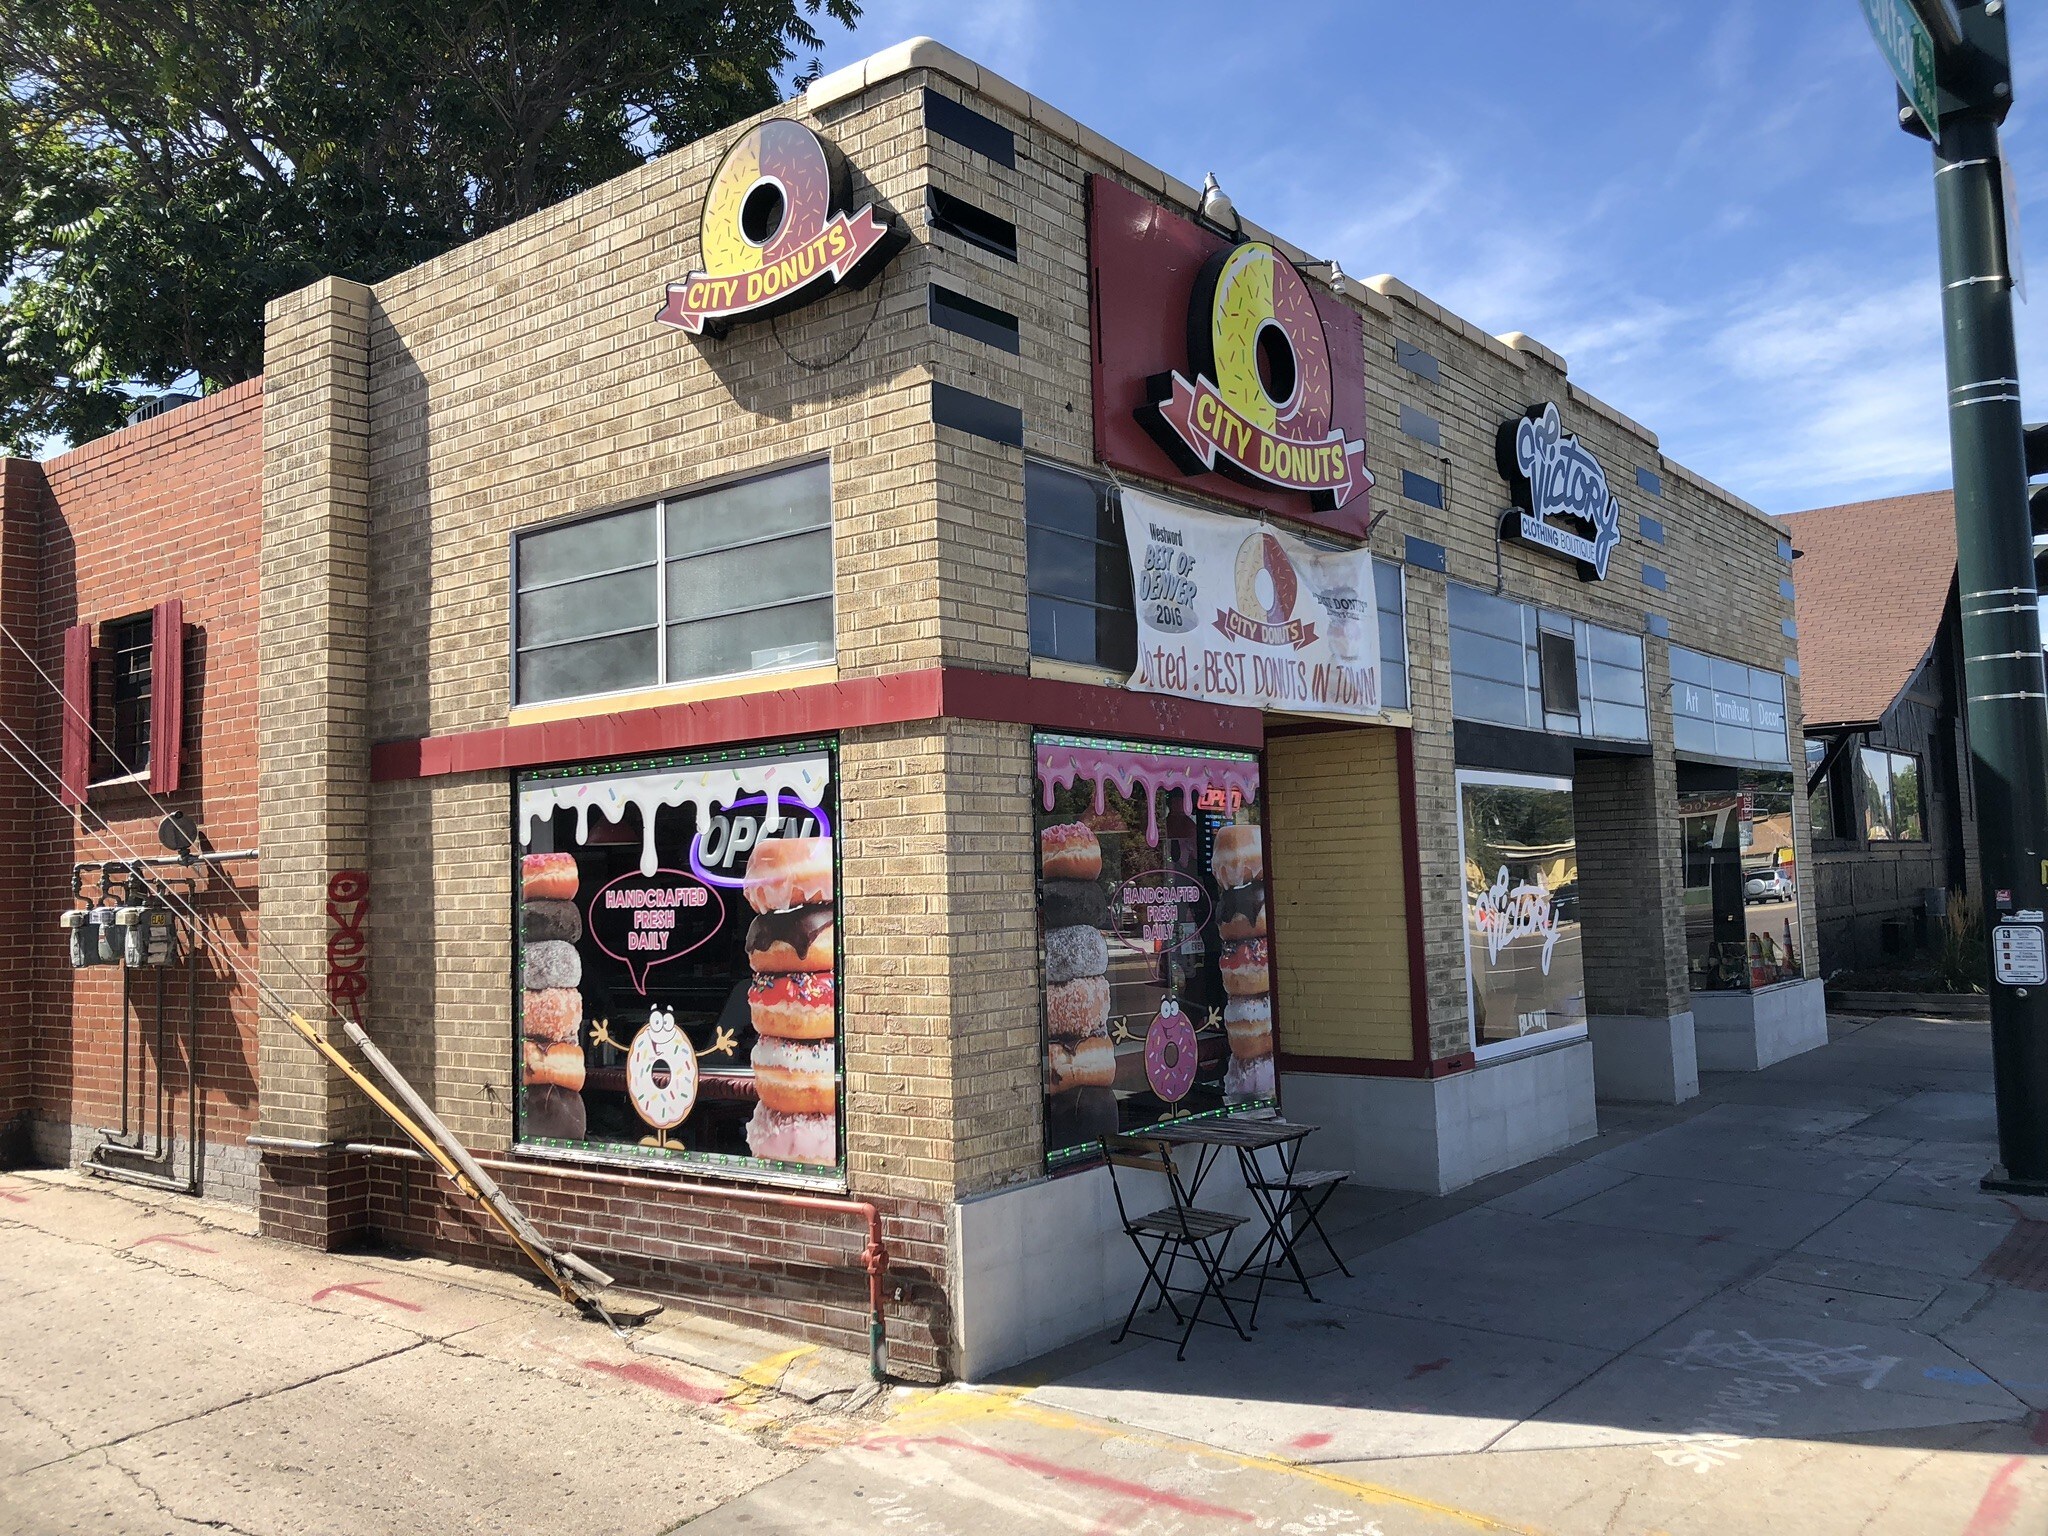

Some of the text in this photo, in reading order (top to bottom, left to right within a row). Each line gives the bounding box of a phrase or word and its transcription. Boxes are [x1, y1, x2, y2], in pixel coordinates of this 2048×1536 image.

[687, 223, 847, 310] CITY DONUTS
[1196, 392, 1345, 484] CITY DONUTS
[1148, 522, 1183, 547] Westword
[1522, 516, 1595, 561] CLOTHING BOUTIQUE
[1144, 543, 1196, 578] BEST OF
[1139, 570, 1198, 610] DENVER
[1156, 604, 1183, 626] 2016
[1229, 612, 1299, 645] CITY DONUTS
[1204, 649, 1247, 696] BEST
[1253, 654, 1308, 702] DONUTS
[1312, 663, 1331, 703] IN
[1685, 686, 1780, 727] Art Furniture Decor
[605, 887, 708, 909] HANDCRAFTED
[1123, 886, 1200, 904] HANDCRAFTED
[633, 909, 675, 929] FRESH
[1147, 905, 1178, 922] FRESH
[628, 931, 669, 950] DAILY
[1142, 923, 1174, 942] DAILY
